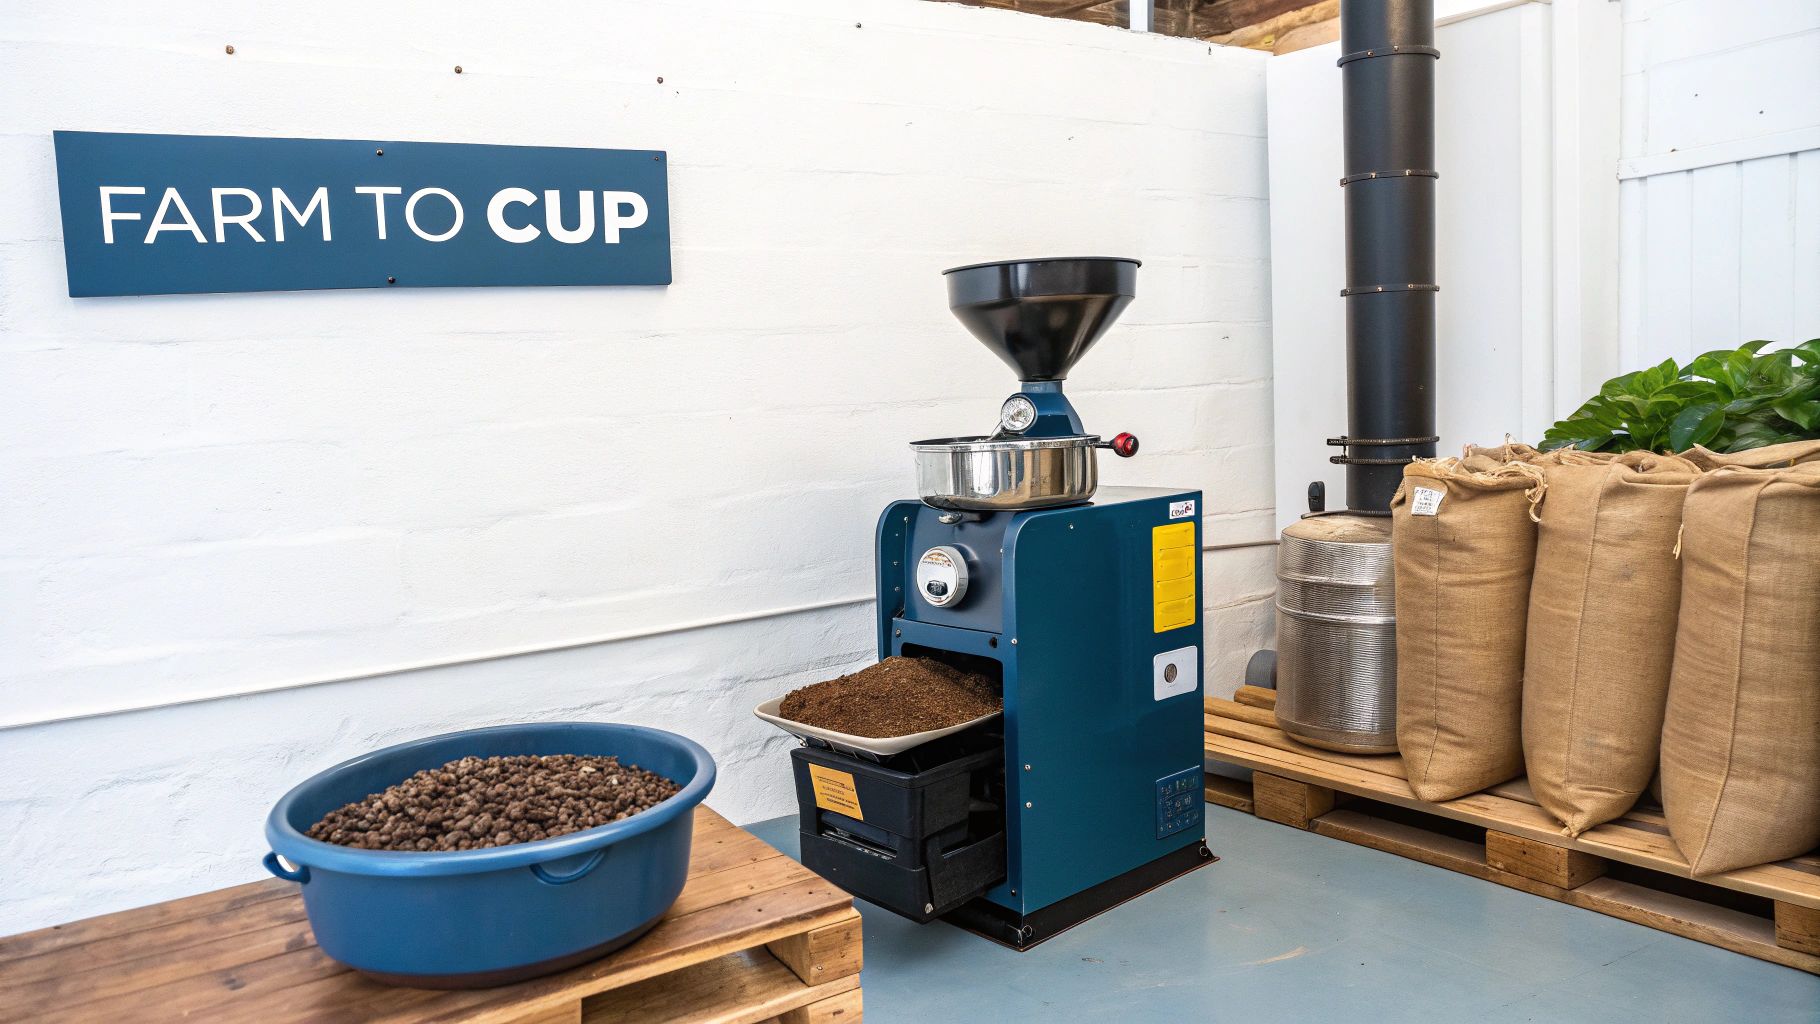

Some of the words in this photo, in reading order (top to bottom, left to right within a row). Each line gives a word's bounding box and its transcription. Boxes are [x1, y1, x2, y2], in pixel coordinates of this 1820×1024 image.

[99, 186, 332, 244] FARM
[355, 186, 464, 242] TO
[486, 187, 649, 244] CUP
